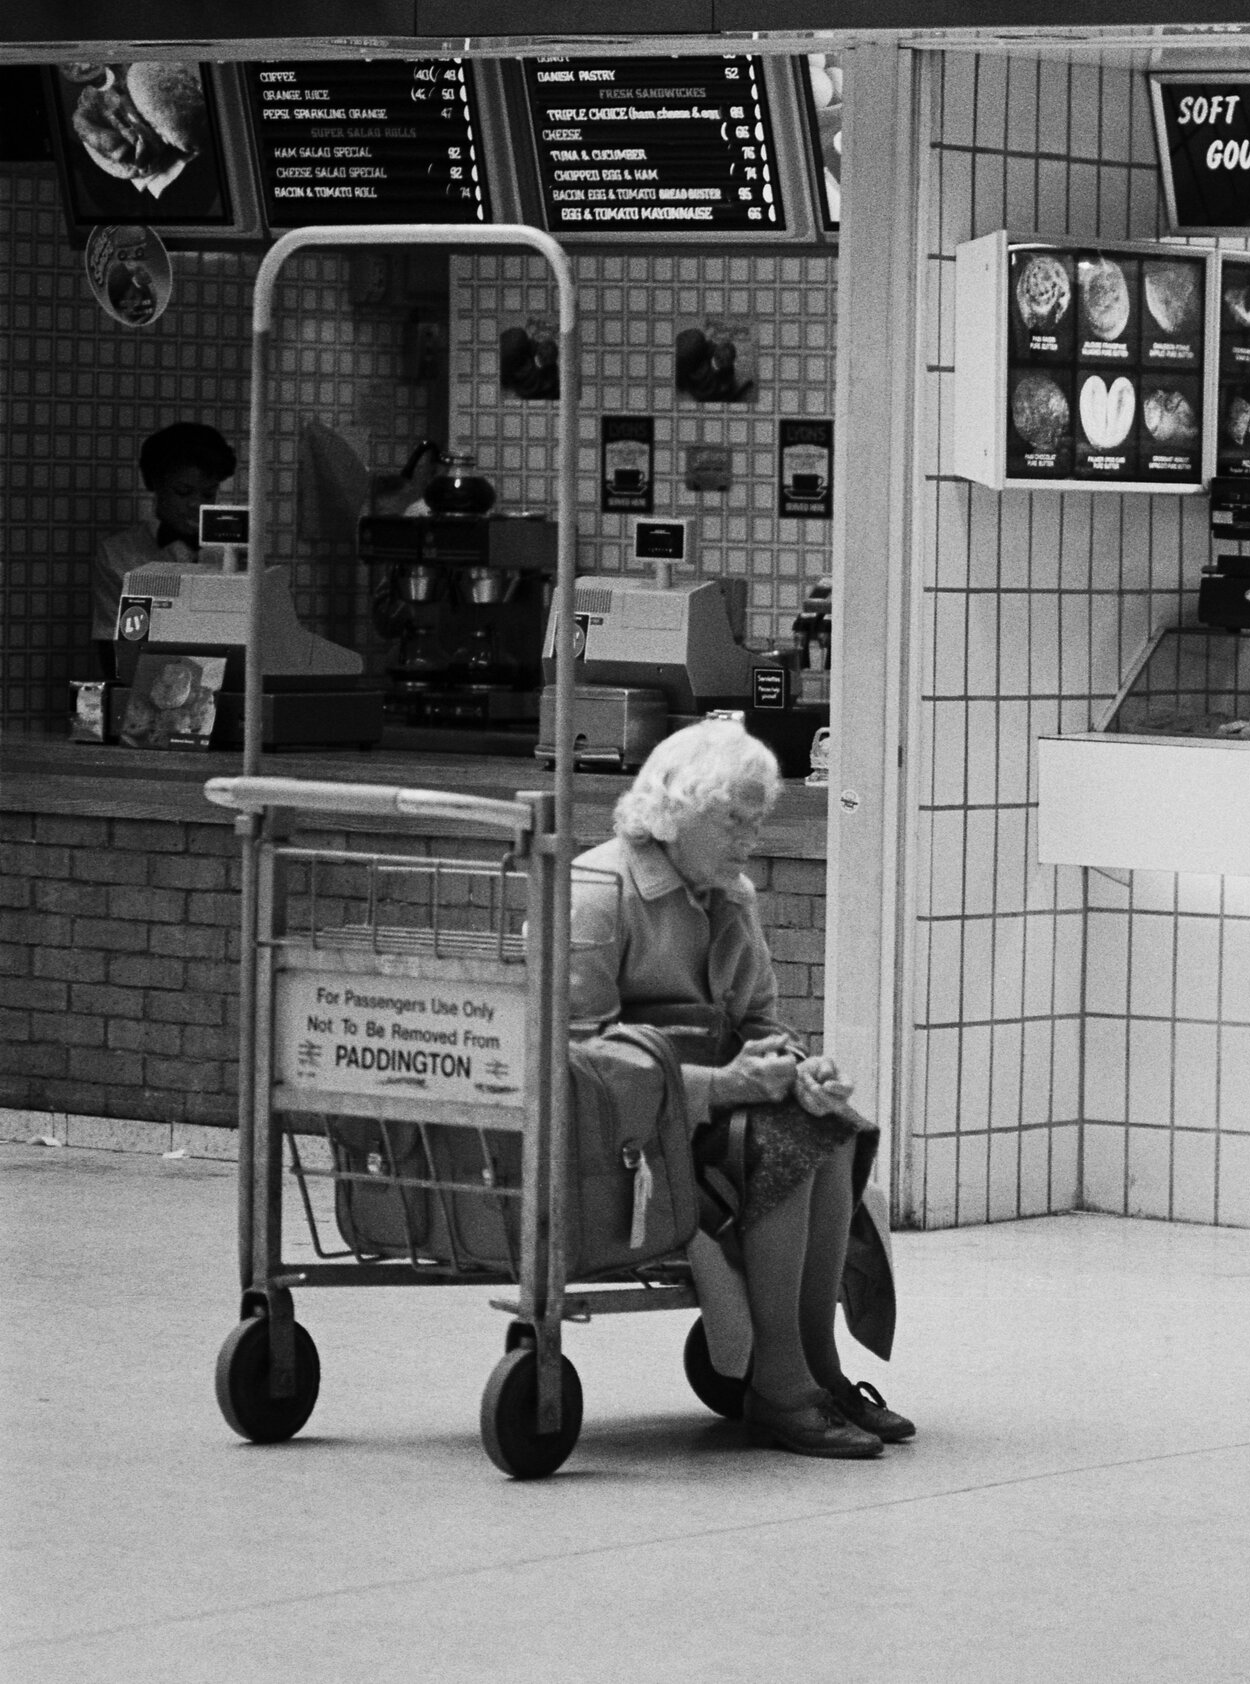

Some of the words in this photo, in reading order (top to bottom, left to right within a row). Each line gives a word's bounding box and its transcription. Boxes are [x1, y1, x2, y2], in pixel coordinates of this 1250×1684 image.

[260, 71, 297, 82] COFFEE
[537, 71, 575, 82] DANISH
[579, 70, 616, 81] PASTRY
[725, 67, 739, 79] 52
[263, 90, 302, 100] ORANGE
[305, 90, 330, 100] JUICE
[600, 89, 633, 99] FRESH
[634, 88, 706, 98] SANDWICHES
[294, 109, 346, 119] SPARKLING
[349, 109, 387, 119] ORANGE
[546, 109, 588, 121] TRIPLE
[589, 108, 628, 120] CHOICE
[1177, 96, 1240, 125] SOFT
[311, 128, 344, 138] SUPER
[347, 128, 380, 138] SALAD
[384, 128, 417, 138] ROLLS
[542, 129, 583, 140] CHEESE
[275, 147, 297, 158] HAM
[300, 147, 331, 158] SALAD
[334, 147, 372, 158] SPECIAL
[550, 150, 580, 161] TUNA
[582, 150, 590, 161] &
[592, 149, 647, 160] CUCUMBER
[276, 167, 312, 178] CHEESE
[315, 167, 346, 178] SALAD
[349, 167, 387, 178] SPECIAL
[554, 170, 600, 181] CHOPPED
[602, 169, 622, 180] EGG
[624, 169, 632, 180] &
[634, 169, 659, 180] HAM
[275, 187, 304, 198] BACON
[306, 187, 313, 198] &
[315, 187, 352, 198] TOMATO
[355, 187, 377, 198] ROLL
[588, 189, 607, 200] EGG
[608, 189, 616, 200] &
[617, 189, 656, 199] TOMATO
[561, 208, 582, 220] EGG
[583, 208, 593, 220] &
[594, 207, 639, 220] TOMATO
[641, 207, 713, 220] MAYONNAISE
[317, 987, 339, 1004] For
[345, 989, 426, 1014] Passengers
[431, 998, 458, 1015] Use
[463, 1001, 494, 1022] Only
[307, 1016, 333, 1034] Not
[341, 1018, 358, 1035] To
[366, 1021, 385, 1038] Be
[392, 1023, 457, 1046] Removed
[463, 1030, 499, 1049] From
[335, 1045, 471, 1079] PADDINGTON
